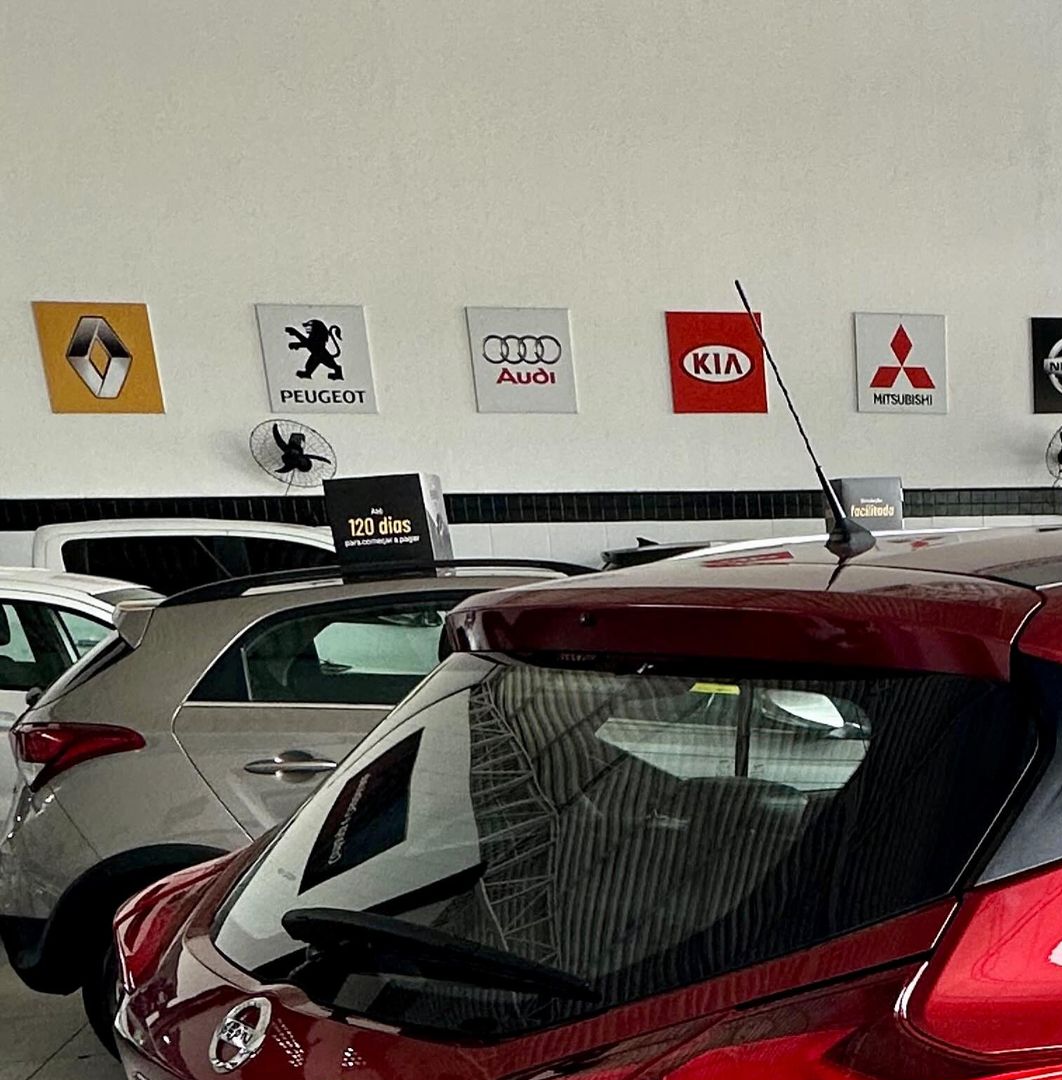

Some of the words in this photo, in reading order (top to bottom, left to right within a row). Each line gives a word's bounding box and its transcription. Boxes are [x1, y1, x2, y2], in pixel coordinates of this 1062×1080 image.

[692, 352, 743, 375] KIA
[496, 367, 556, 384] Audi
[280, 389, 366, 404] PEUGEOT
[873, 393, 933, 406] MITSUBISHI
[348, 518, 374, 536] 120
[379, 516, 411, 535] dias
